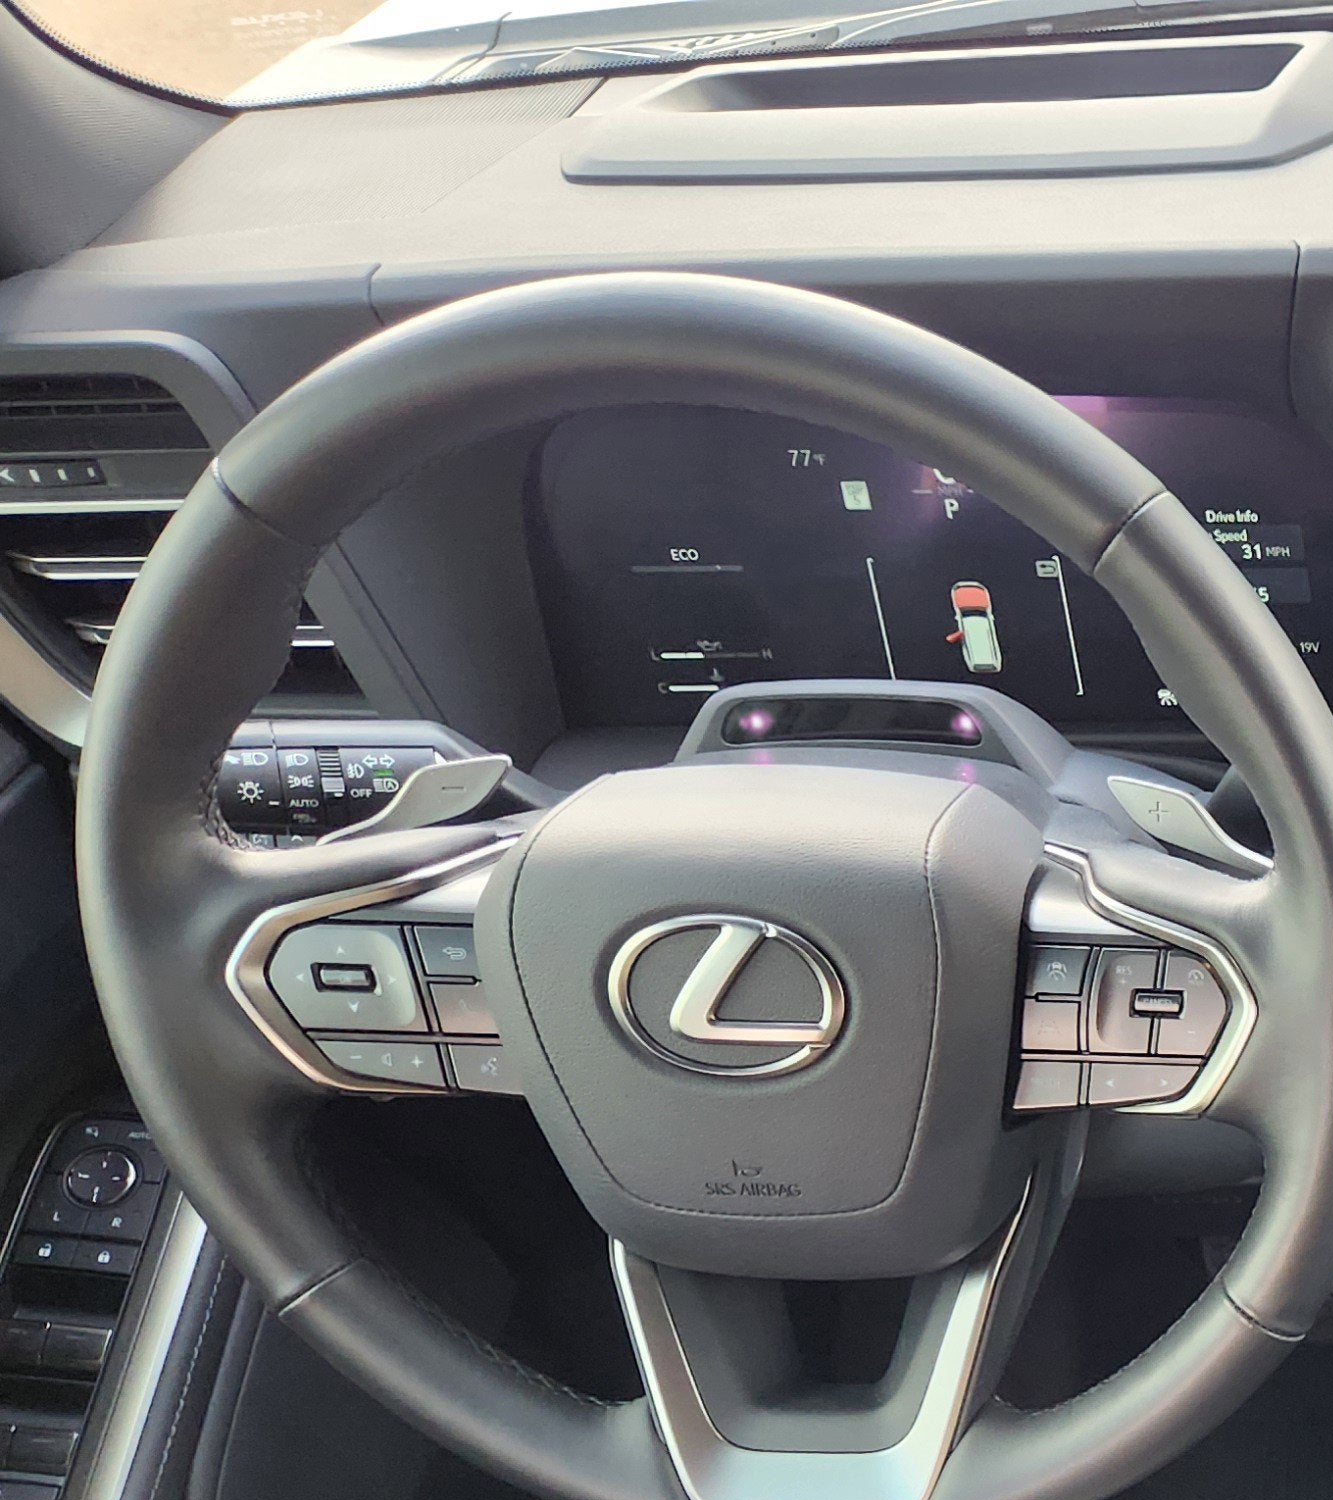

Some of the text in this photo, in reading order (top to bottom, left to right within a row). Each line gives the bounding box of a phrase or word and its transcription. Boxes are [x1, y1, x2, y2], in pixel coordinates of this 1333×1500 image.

[943, 498, 960, 520] P
[1205, 509, 1259, 524] Drive Info
[1213, 529, 1248, 544] Speed
[669, 548, 699, 562] ECO
[1241, 544, 1291, 560] 31 MPH
[350, 788, 372, 798] OFF
[289, 799, 318, 807] AUTO
[705, 1181, 802, 1197] SRS AIRBAG
